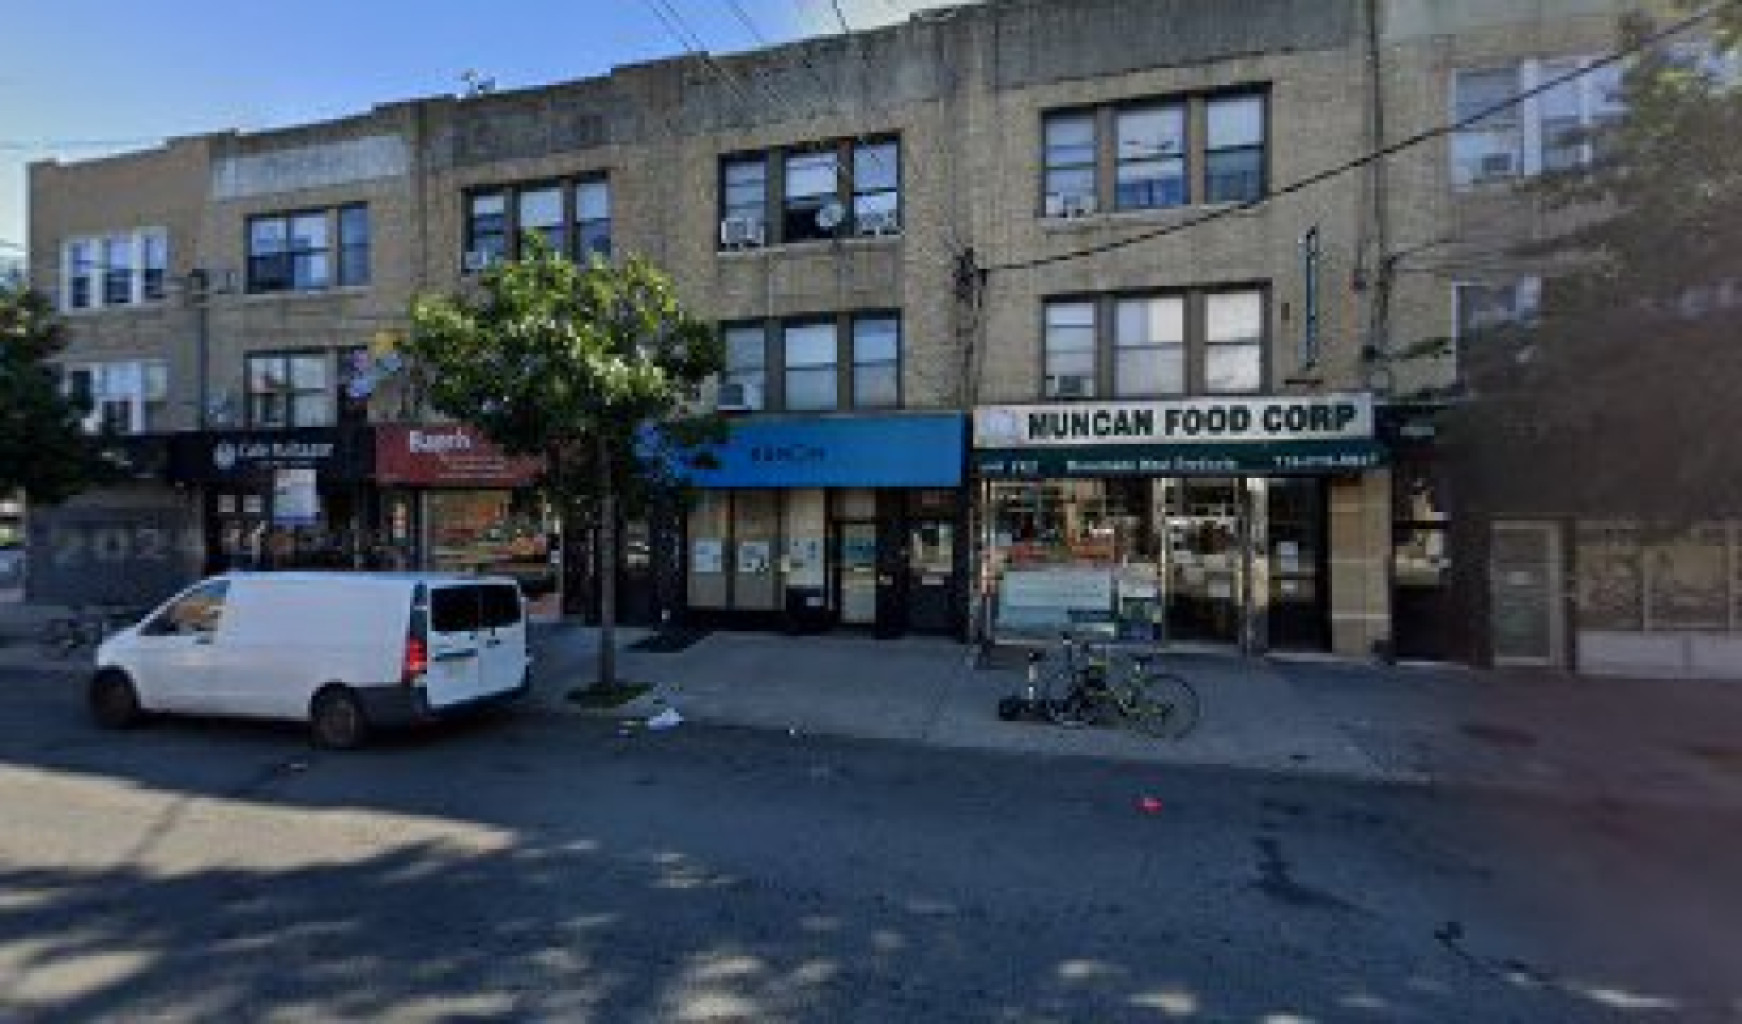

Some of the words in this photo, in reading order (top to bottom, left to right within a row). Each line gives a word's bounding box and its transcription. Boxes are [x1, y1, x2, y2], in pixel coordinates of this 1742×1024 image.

[1028, 409, 1154, 438] MUNCAN
[1165, 406, 1250, 436] FOOD
[1264, 404, 1355, 432] CORP
